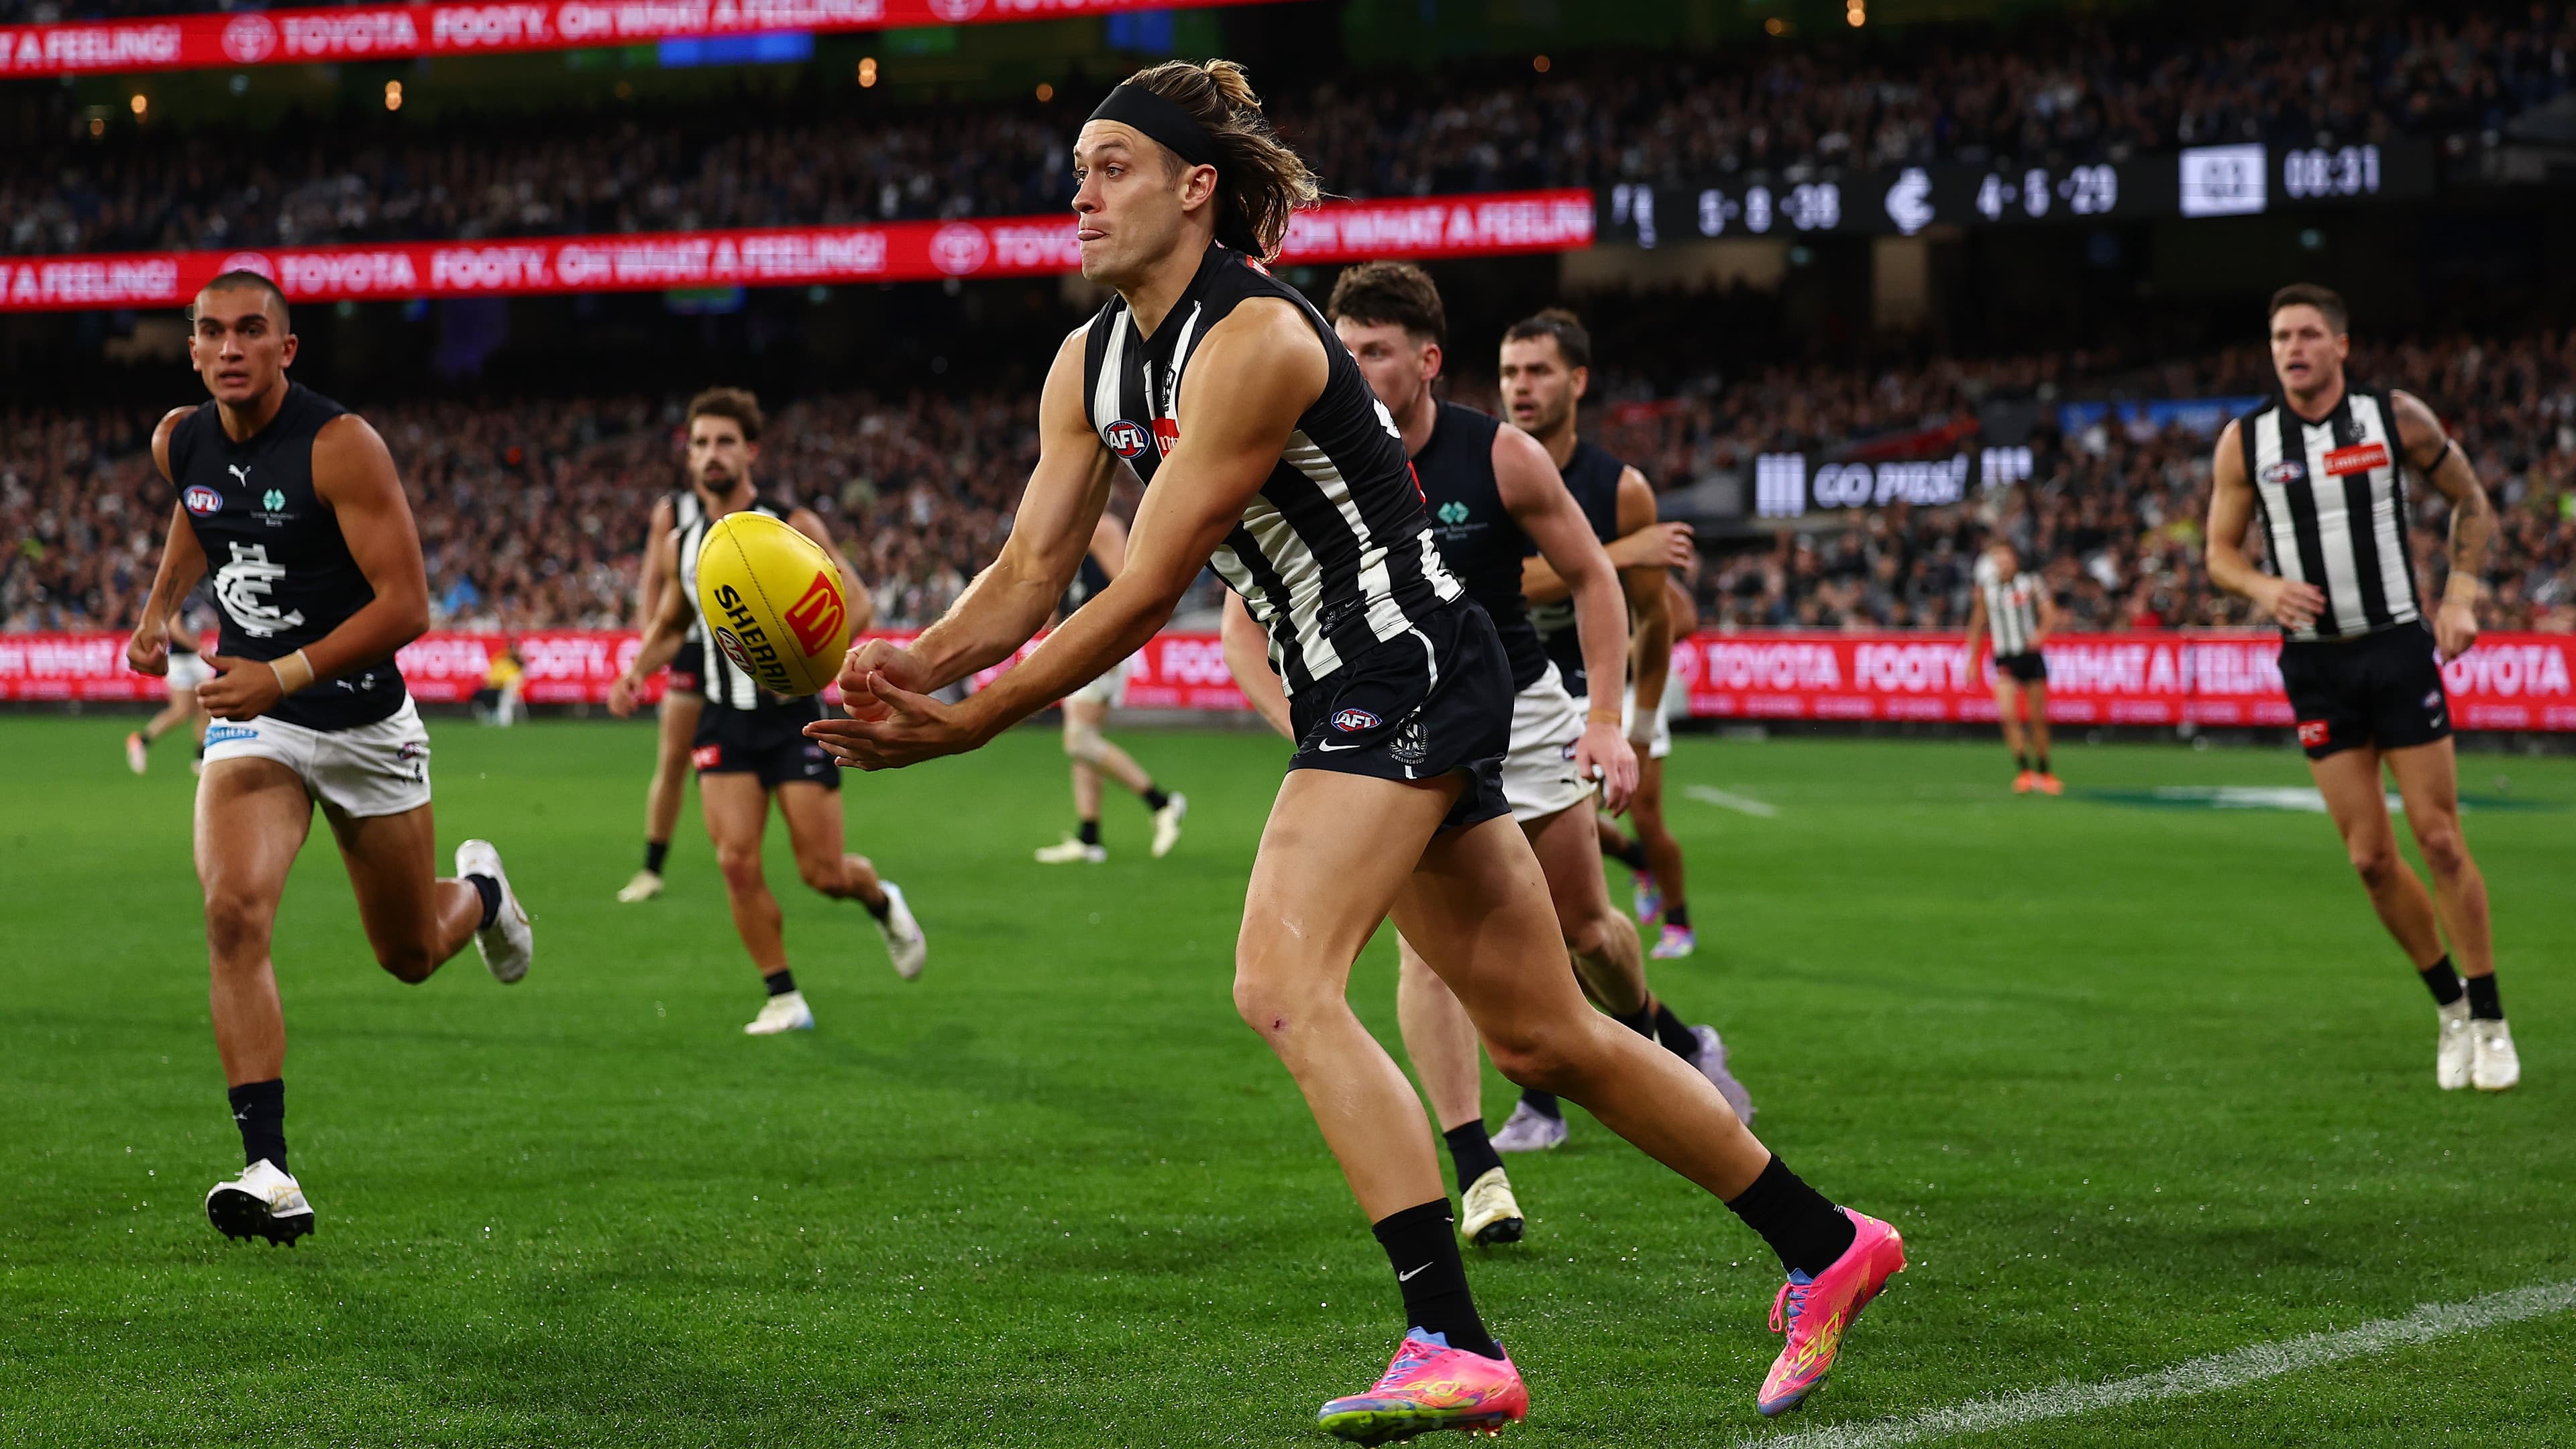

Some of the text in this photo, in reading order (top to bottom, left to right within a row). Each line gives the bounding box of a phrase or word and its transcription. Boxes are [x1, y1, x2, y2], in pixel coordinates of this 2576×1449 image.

[281, 13, 419, 56] TOYOTA
[993, 226, 1081, 266] TOYO
[278, 252, 417, 294] TOYOTA
[1109, 429, 1145, 449] AFL
[187, 491, 219, 512] AFL
[1813, 462, 1874, 508] GO
[1707, 642, 1841, 690] TOYOTA
